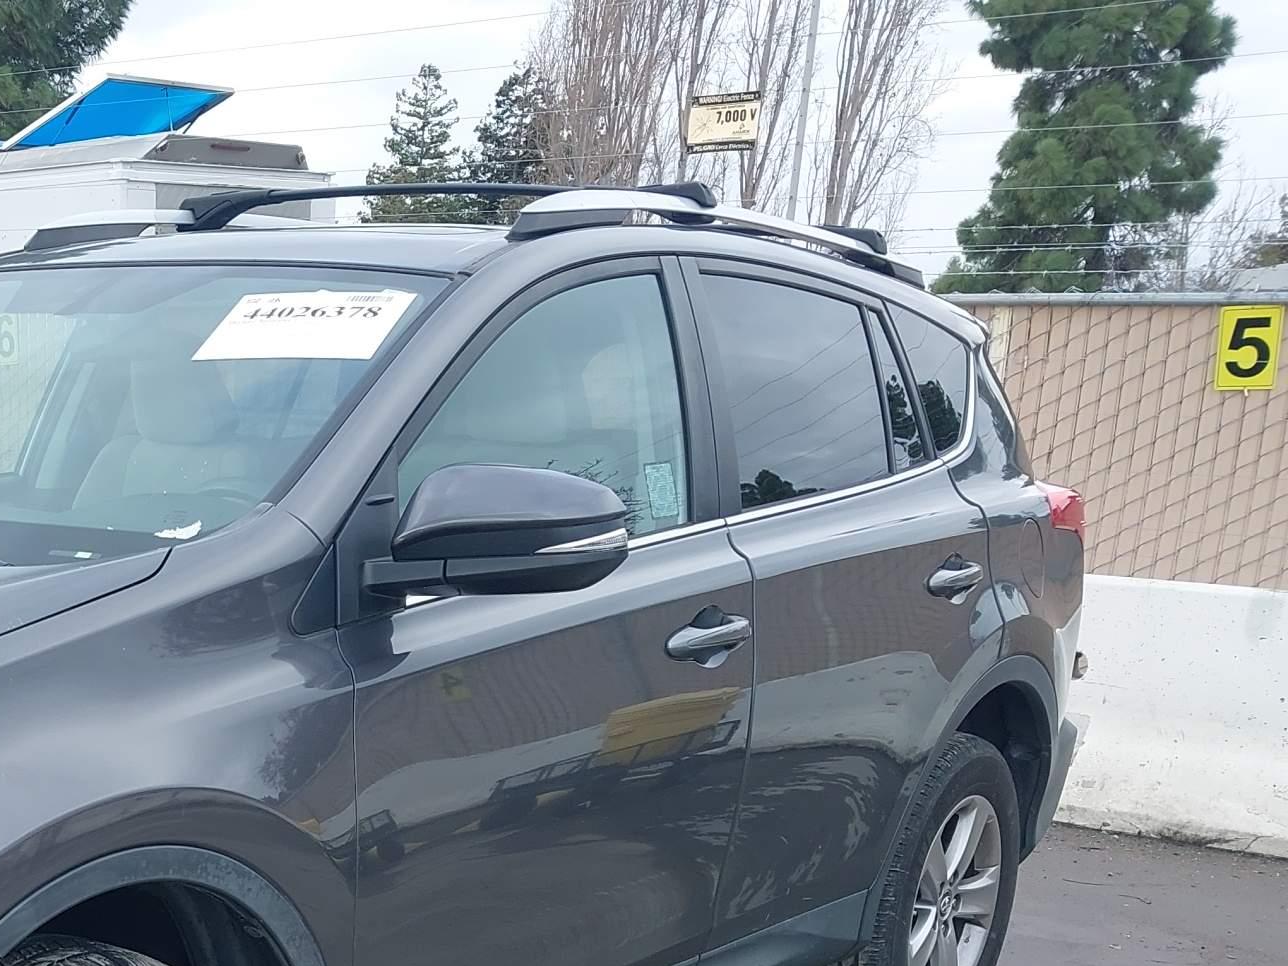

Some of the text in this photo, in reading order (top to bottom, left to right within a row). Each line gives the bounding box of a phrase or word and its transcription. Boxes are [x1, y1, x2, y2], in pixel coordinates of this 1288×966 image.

[716, 108, 758, 125] 7,000 V
[243, 306, 382, 320] 44026378
[1225, 317, 1272, 379] 5
